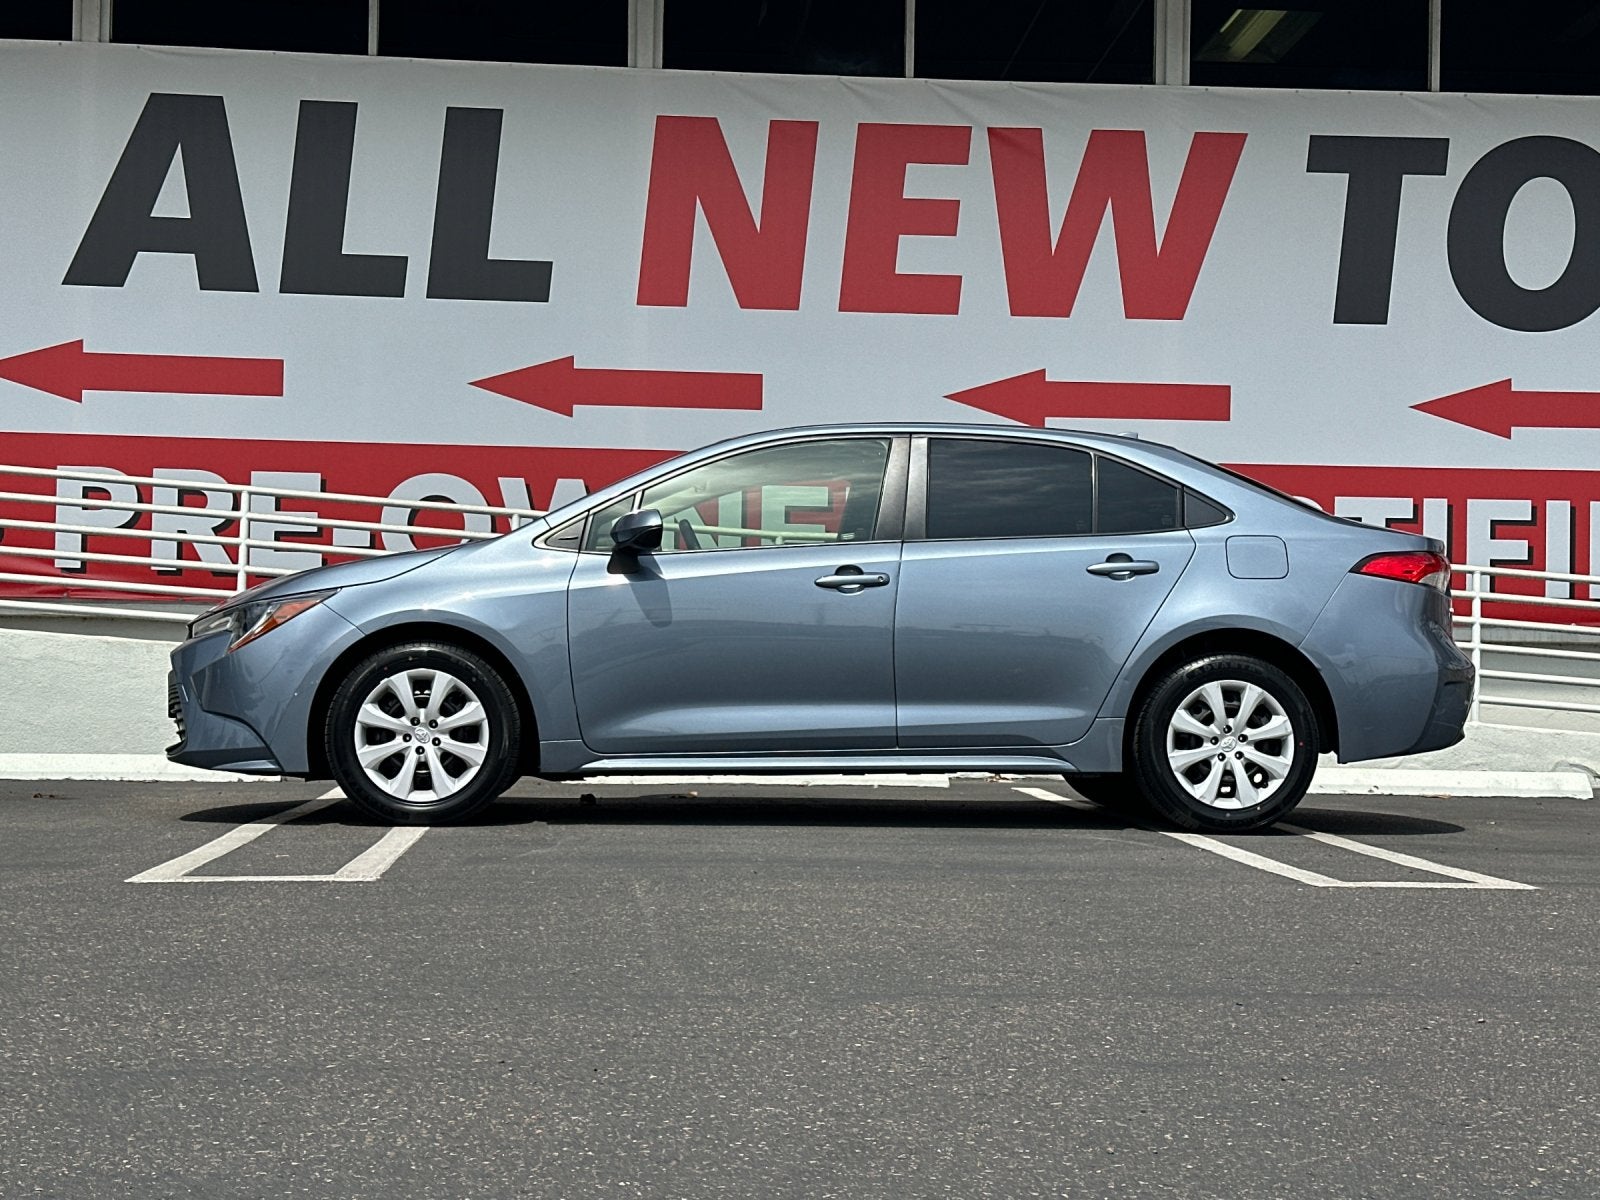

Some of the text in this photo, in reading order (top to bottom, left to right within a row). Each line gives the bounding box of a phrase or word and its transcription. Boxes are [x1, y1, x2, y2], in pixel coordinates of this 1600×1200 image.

[61, 93, 1600, 332] ALL NEW TO
